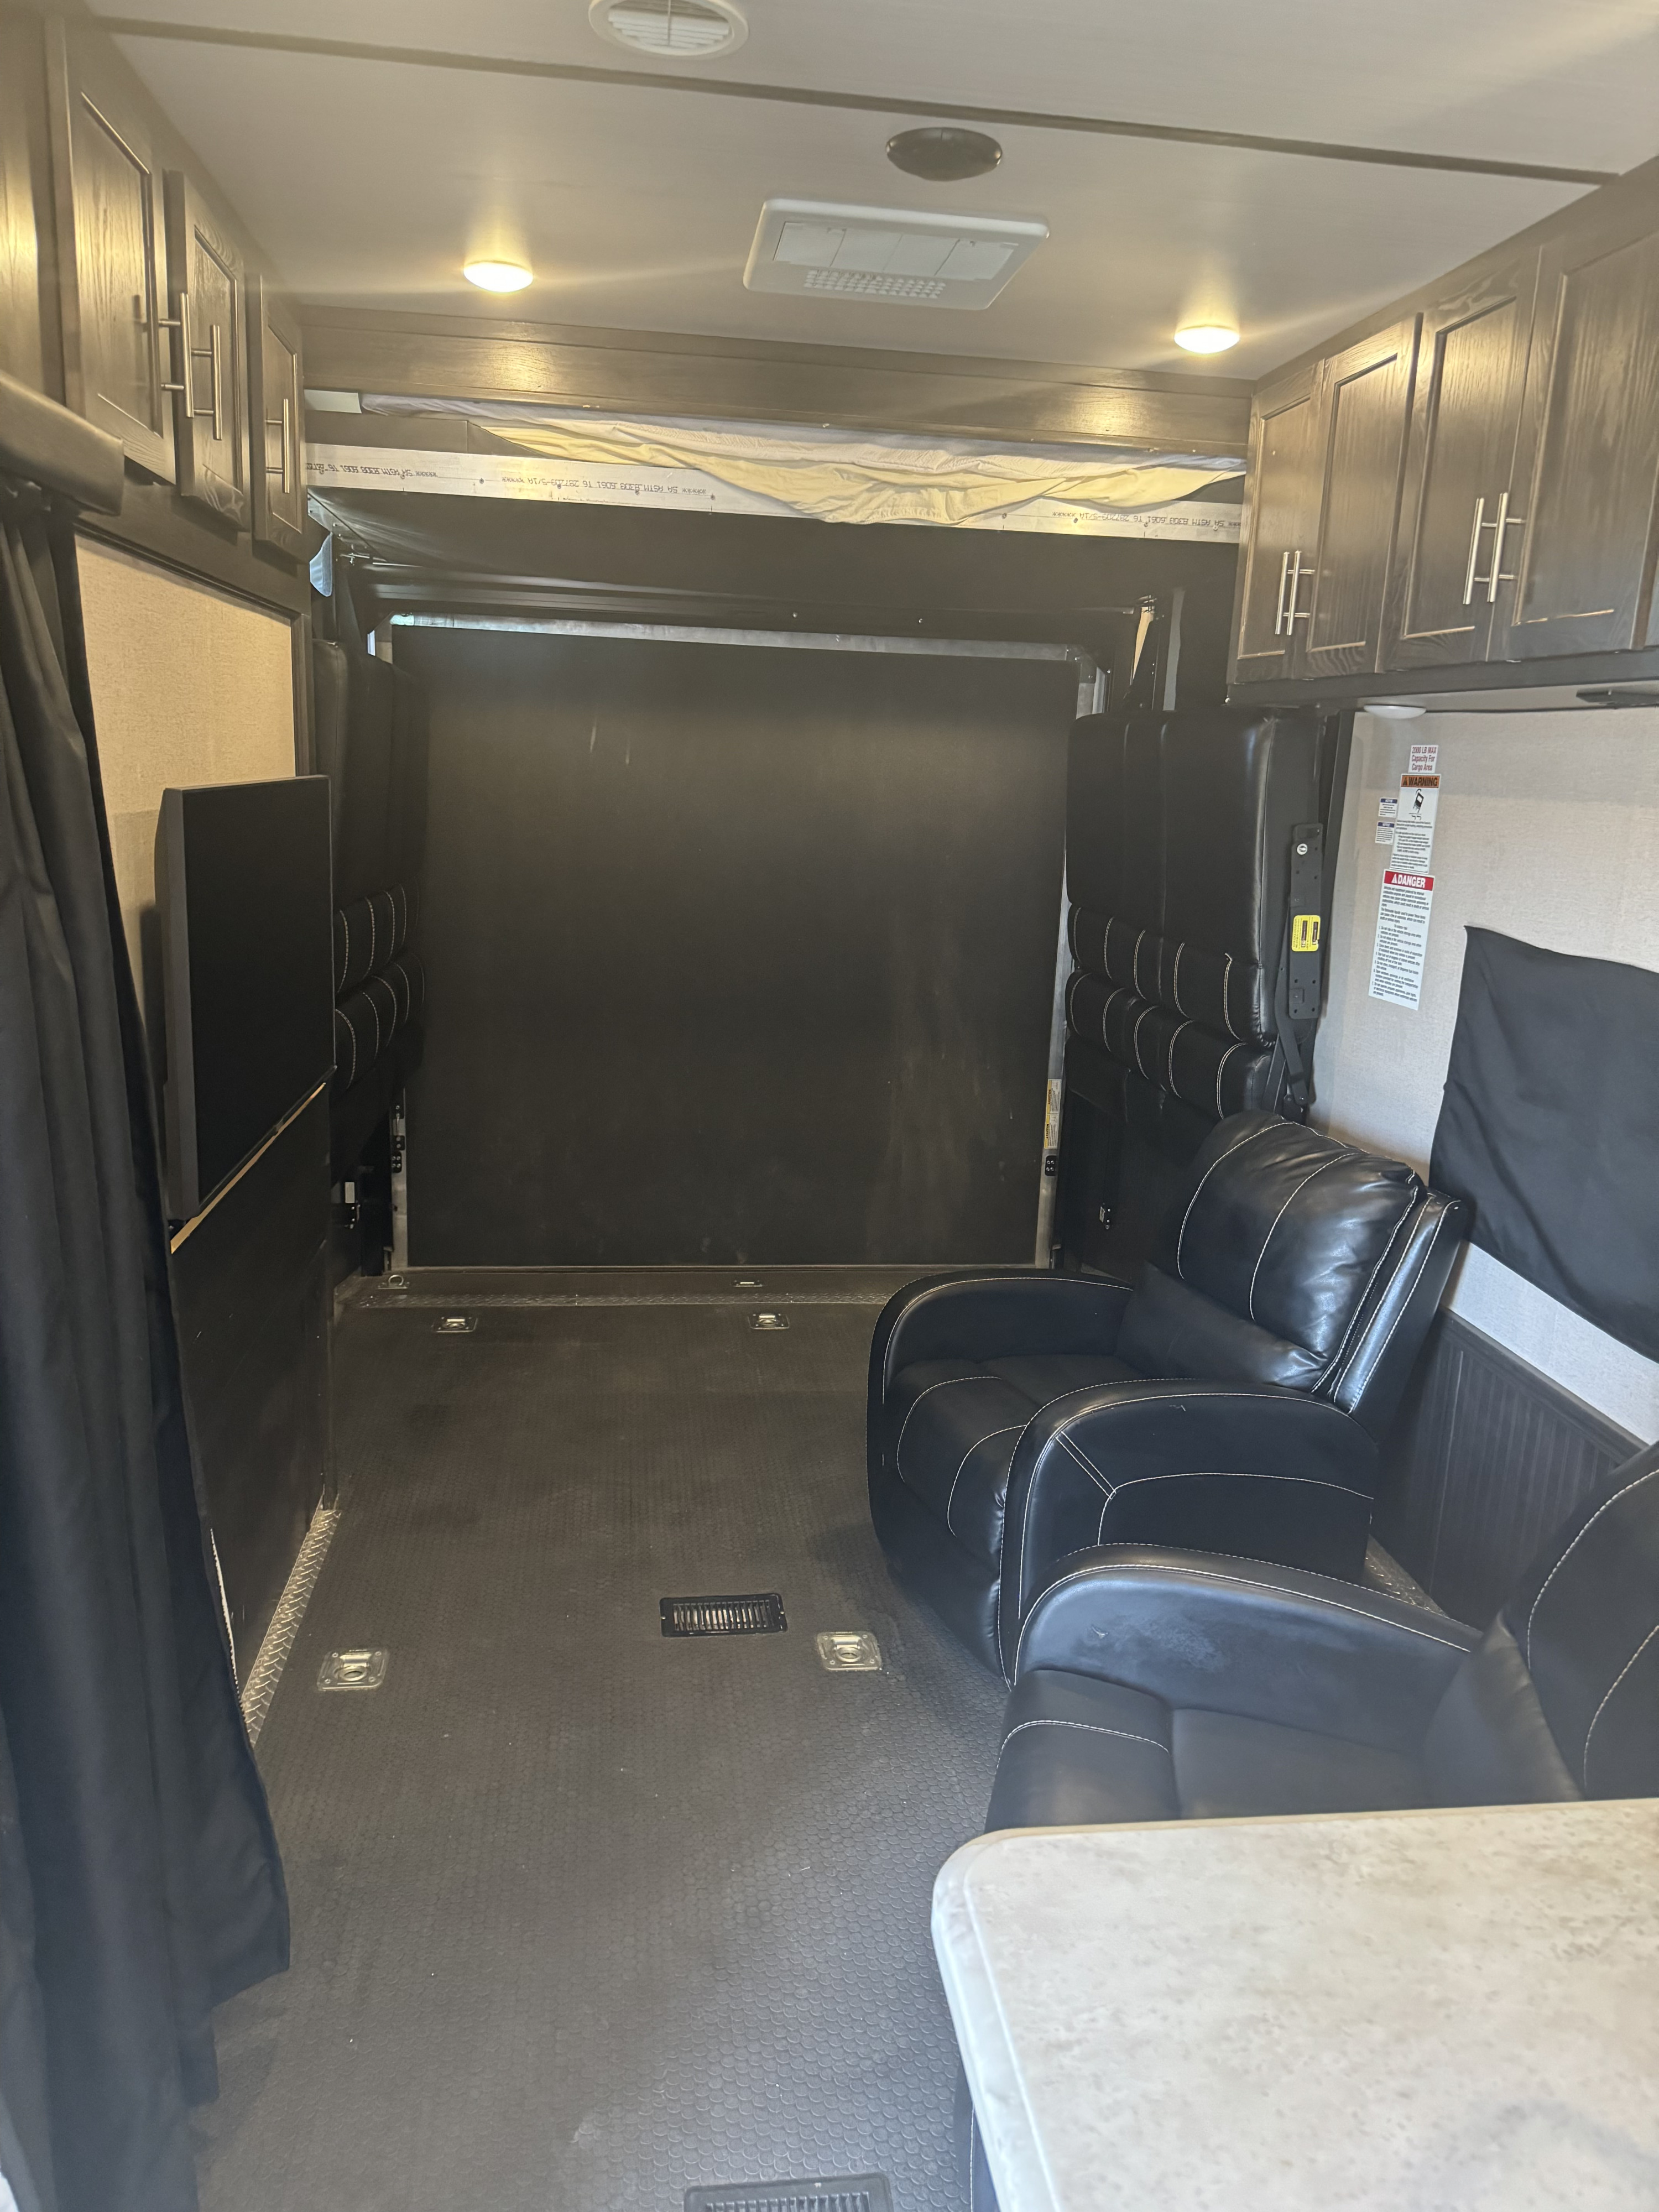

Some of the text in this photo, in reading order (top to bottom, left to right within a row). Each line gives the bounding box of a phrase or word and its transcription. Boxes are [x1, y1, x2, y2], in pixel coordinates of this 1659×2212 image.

[643, 484, 664, 492] ASTM
[1147, 515, 1167, 524] 6061
[1411, 754, 1428, 763] Capacity
[1412, 763, 1423, 772] Cargo
[1408, 776, 1438, 786] WARNING
[1397, 874, 1426, 888] DANGER
